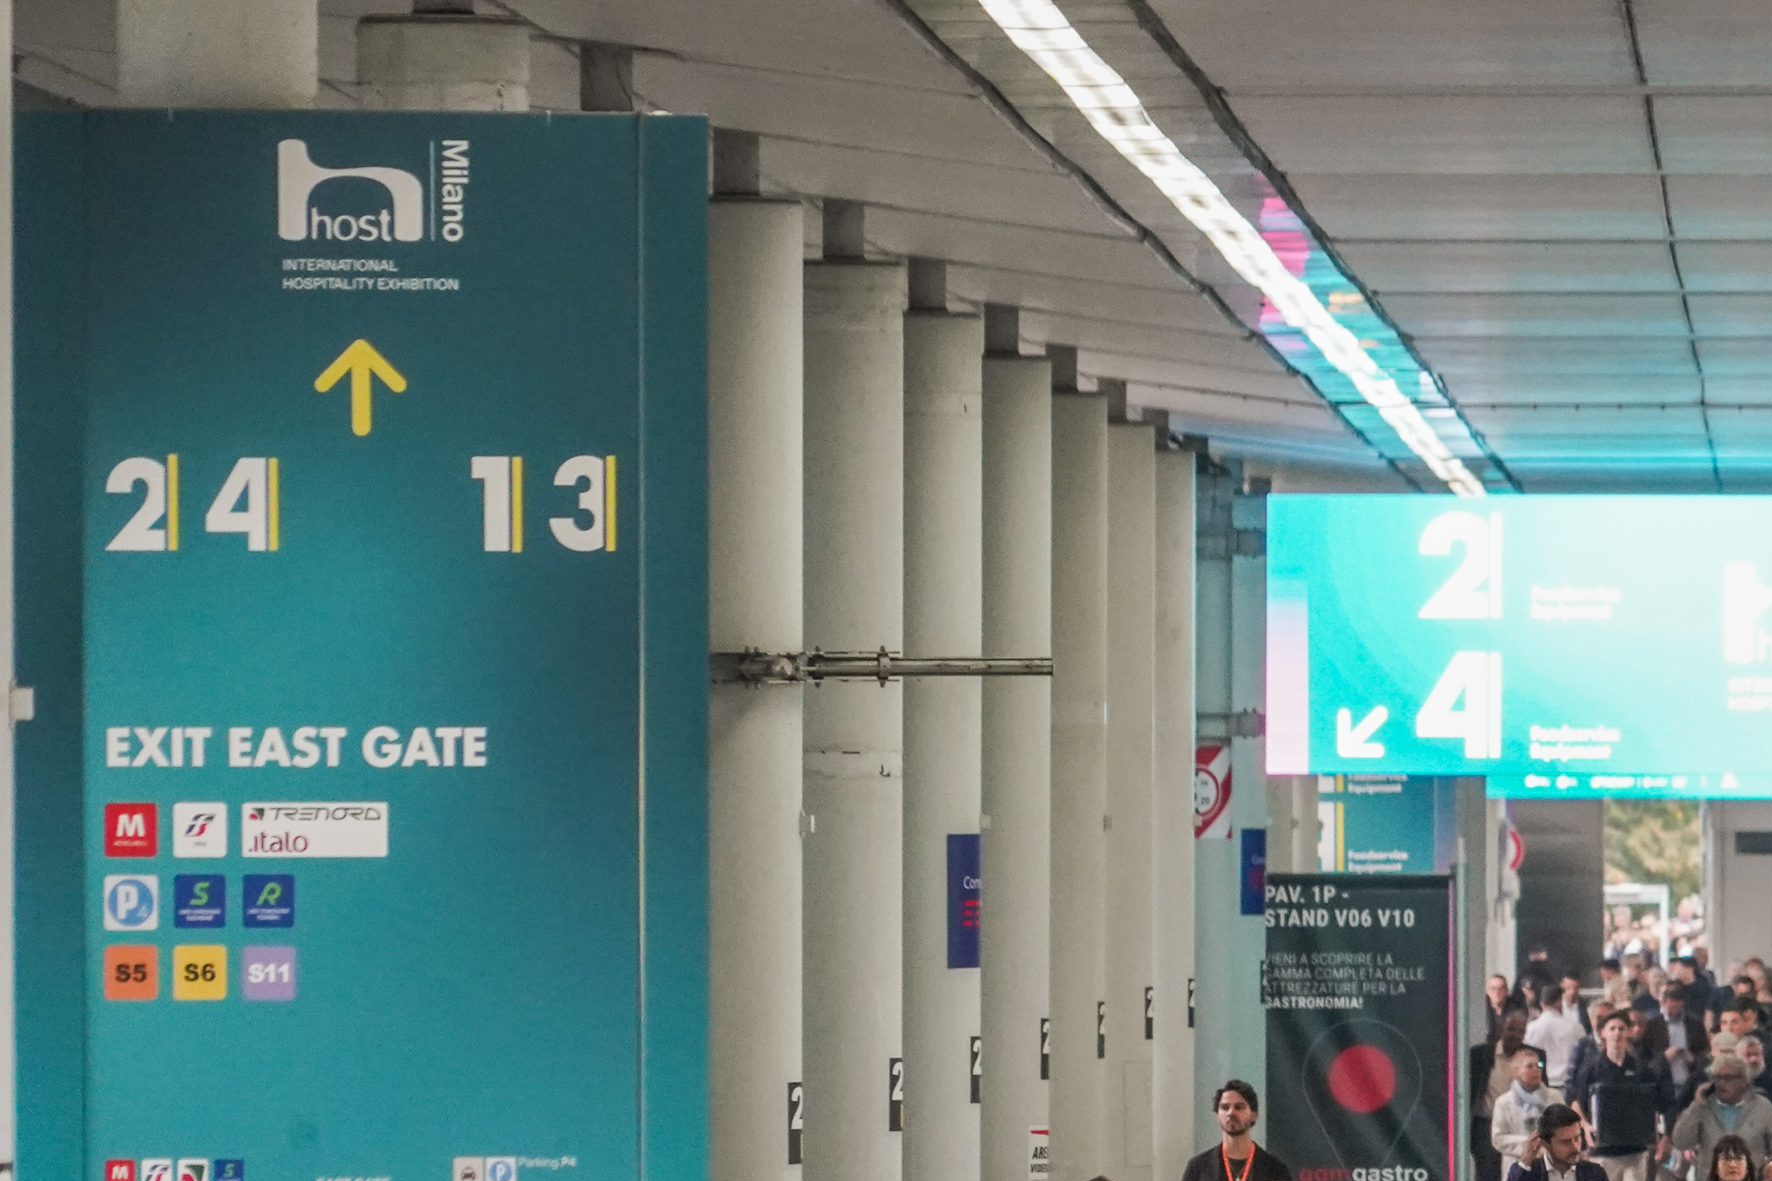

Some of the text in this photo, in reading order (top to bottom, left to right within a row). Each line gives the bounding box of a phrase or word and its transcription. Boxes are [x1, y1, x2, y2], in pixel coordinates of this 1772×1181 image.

[442, 139, 469, 242] Milano
[311, 207, 392, 241] host
[282, 258, 398, 272] INTERNATIONAL
[282, 277, 459, 291] HOSPITALITY EXHIBITION
[105, 457, 267, 551] 2 4
[470, 456, 604, 552] 1 3
[1418, 511, 1489, 618] 2
[1415, 651, 1488, 758] 4
[106, 727, 487, 768] EXIT EAST GATE
[268, 807, 381, 821] TRENORD
[1265, 885, 1304, 903] PAV.
[1312, 885, 1336, 903] 1P
[1265, 909, 1415, 927] STAND V06 V10
[1377, 952, 1393, 966] LA
[115, 963, 147, 983] S5
[183, 963, 216, 983] S6
[248, 963, 291, 984] S11
[1315, 967, 1383, 981] COMPLETA
[1032, 1146, 1049, 1160] ARE
[519, 1157, 557, 1170] Parking
